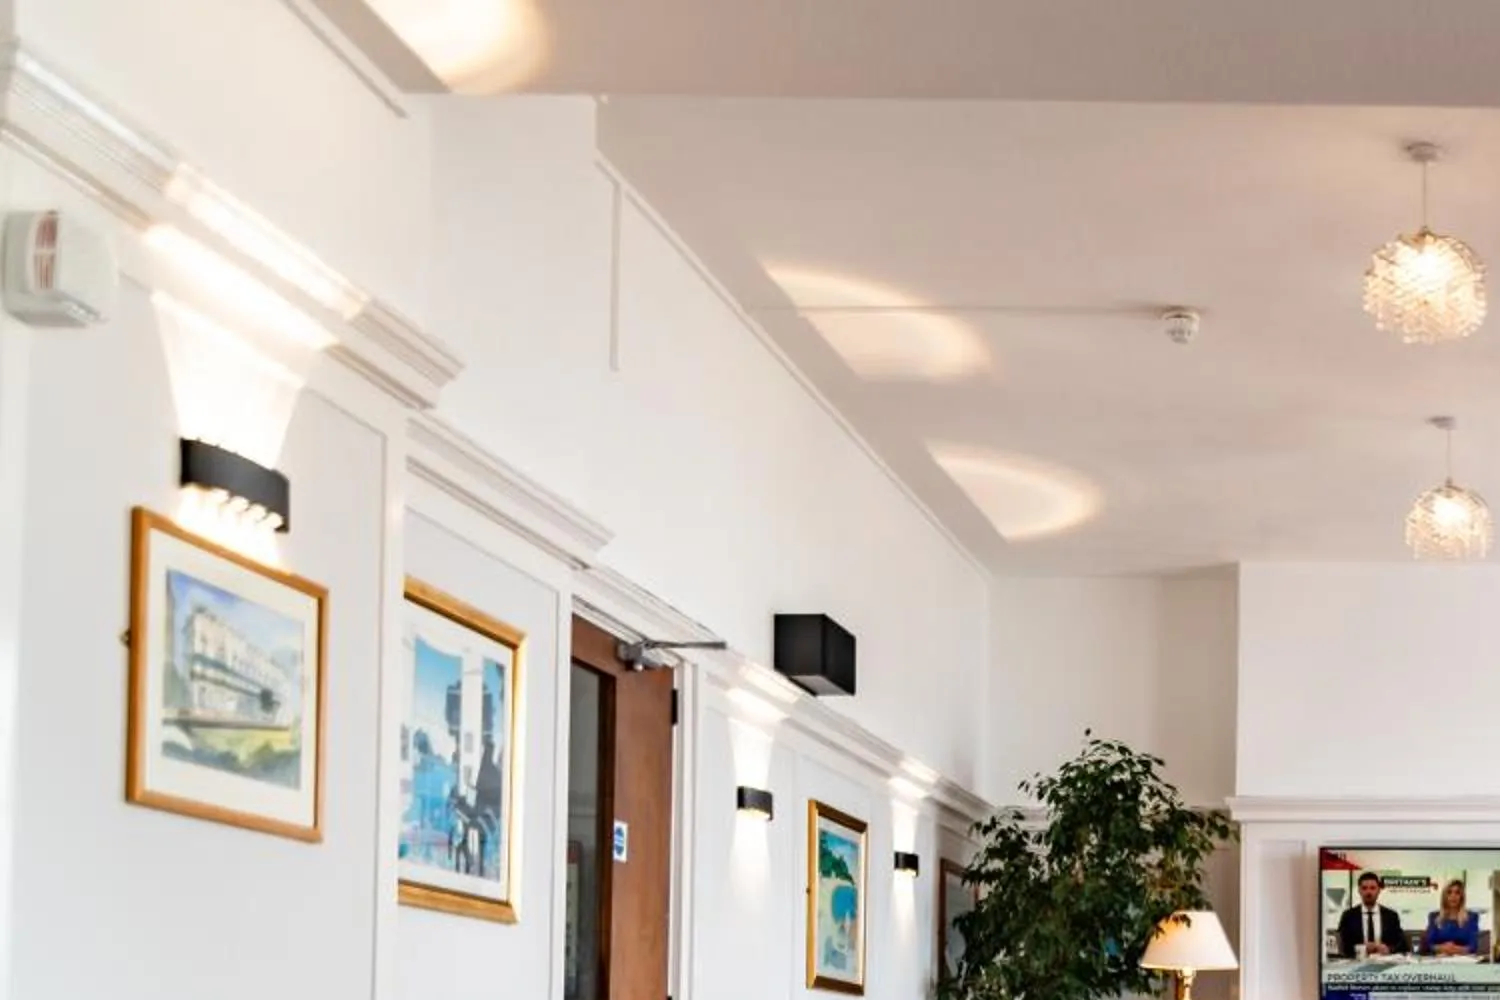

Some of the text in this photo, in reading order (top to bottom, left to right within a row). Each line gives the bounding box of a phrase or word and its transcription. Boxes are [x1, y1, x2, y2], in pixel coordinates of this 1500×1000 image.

[1327, 973, 1456, 982] PROPERTY TAX OVERHAUL
